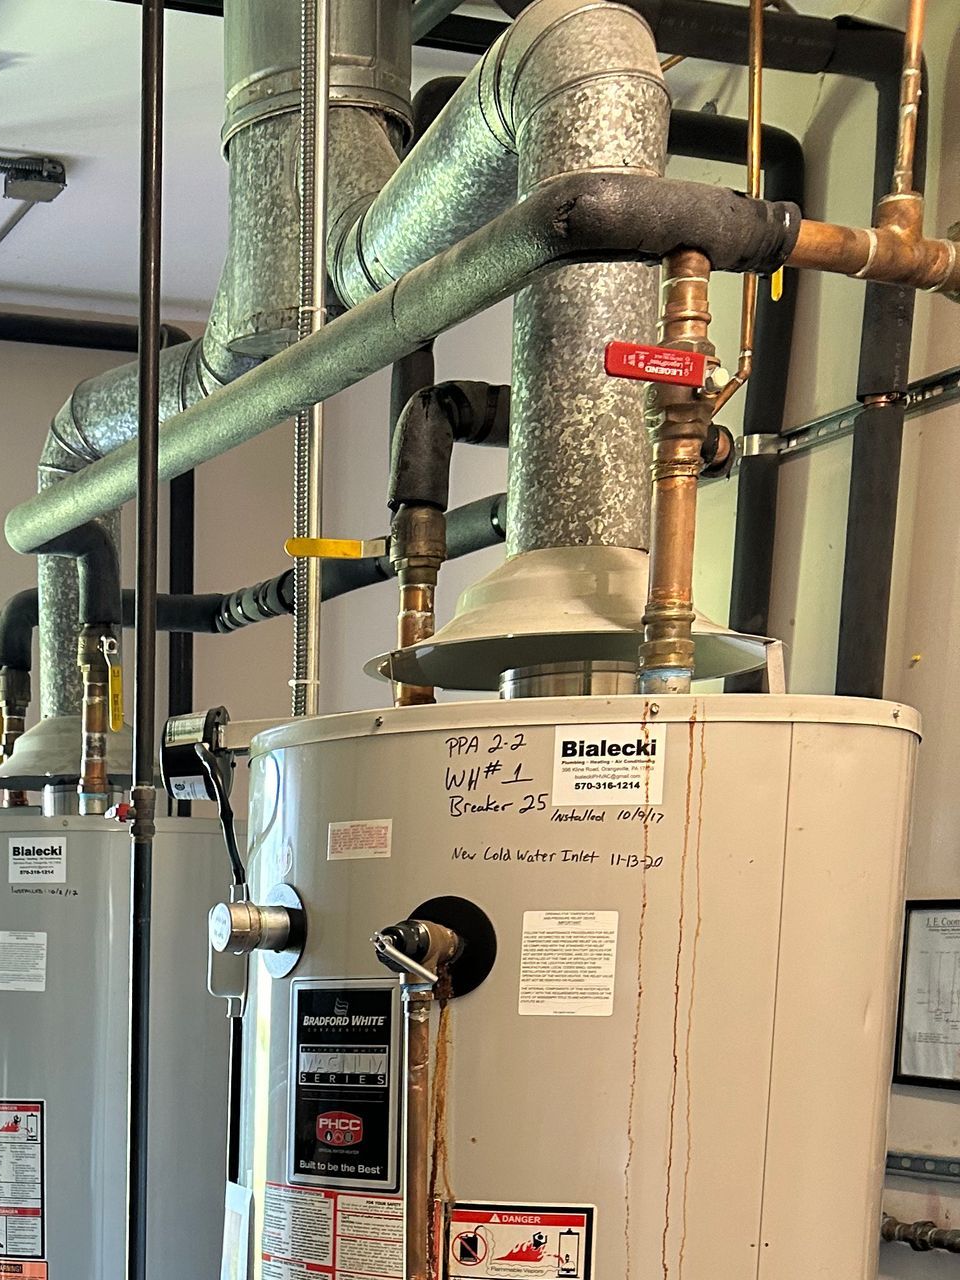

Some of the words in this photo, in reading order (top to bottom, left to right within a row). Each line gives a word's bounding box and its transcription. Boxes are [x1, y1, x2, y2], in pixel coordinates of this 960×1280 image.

[644, 366, 682, 376] LEGEND
[445, 736, 479, 757] PPA
[487, 734, 527, 753] 2-2
[561, 739, 657, 757] Bialecki
[575, 782, 640, 791] 570-316-1214
[449, 796, 513, 817] Breaker
[519, 793, 548, 814] 25
[550, 809, 606, 823] Installed
[12, 846, 62, 857] Bialecki
[451, 847, 477, 861] New
[483, 847, 511, 862] Cold
[516, 849, 557, 863] Water
[561, 849, 600, 863] Inlet
[610, 854, 664, 870] 11-13-20
[303, 1015, 349, 1026] BRADFORD
[351, 1015, 385, 1026] WHITE
[300, 1074, 385, 1085] SERIES
[319, 1118, 361, 1131] PHCC
[299, 1160, 316, 1169] Built
[317, 1162, 326, 1170] to
[327, 1162, 339, 1172] be
[340, 1163, 356, 1173] the
[357, 1165, 381, 1175] Best
[501, 1214, 540, 1224] DANGER
